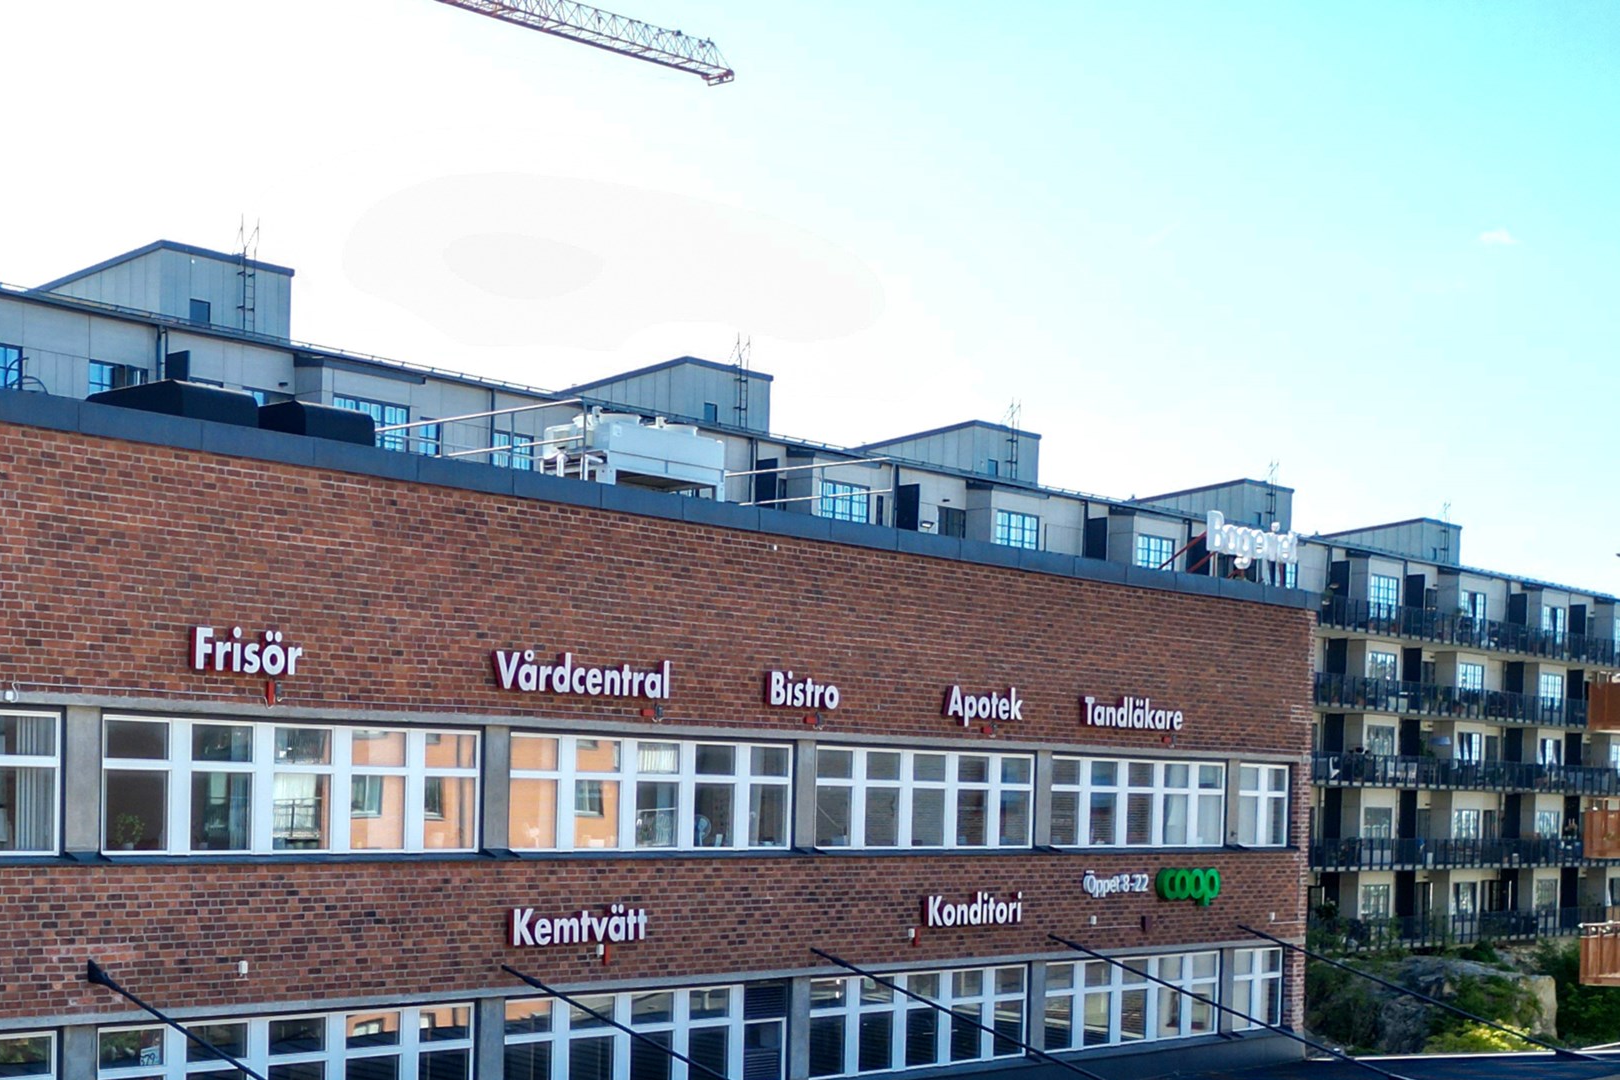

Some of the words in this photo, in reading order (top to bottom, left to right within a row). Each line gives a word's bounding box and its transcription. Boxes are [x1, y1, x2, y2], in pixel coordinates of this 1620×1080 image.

[193, 626, 304, 676] Frisör
[495, 650, 672, 699] Vårdcentral
[769, 670, 840, 710] Bistro
[947, 685, 1023, 727] Apotek
[1084, 696, 1184, 731] Tandläkare
[1083, 870, 1120, 898] Öppet
[1160, 867, 1221, 906] coop
[512, 903, 648, 946] Kemtvätt
[927, 891, 1022, 927] Konditori
